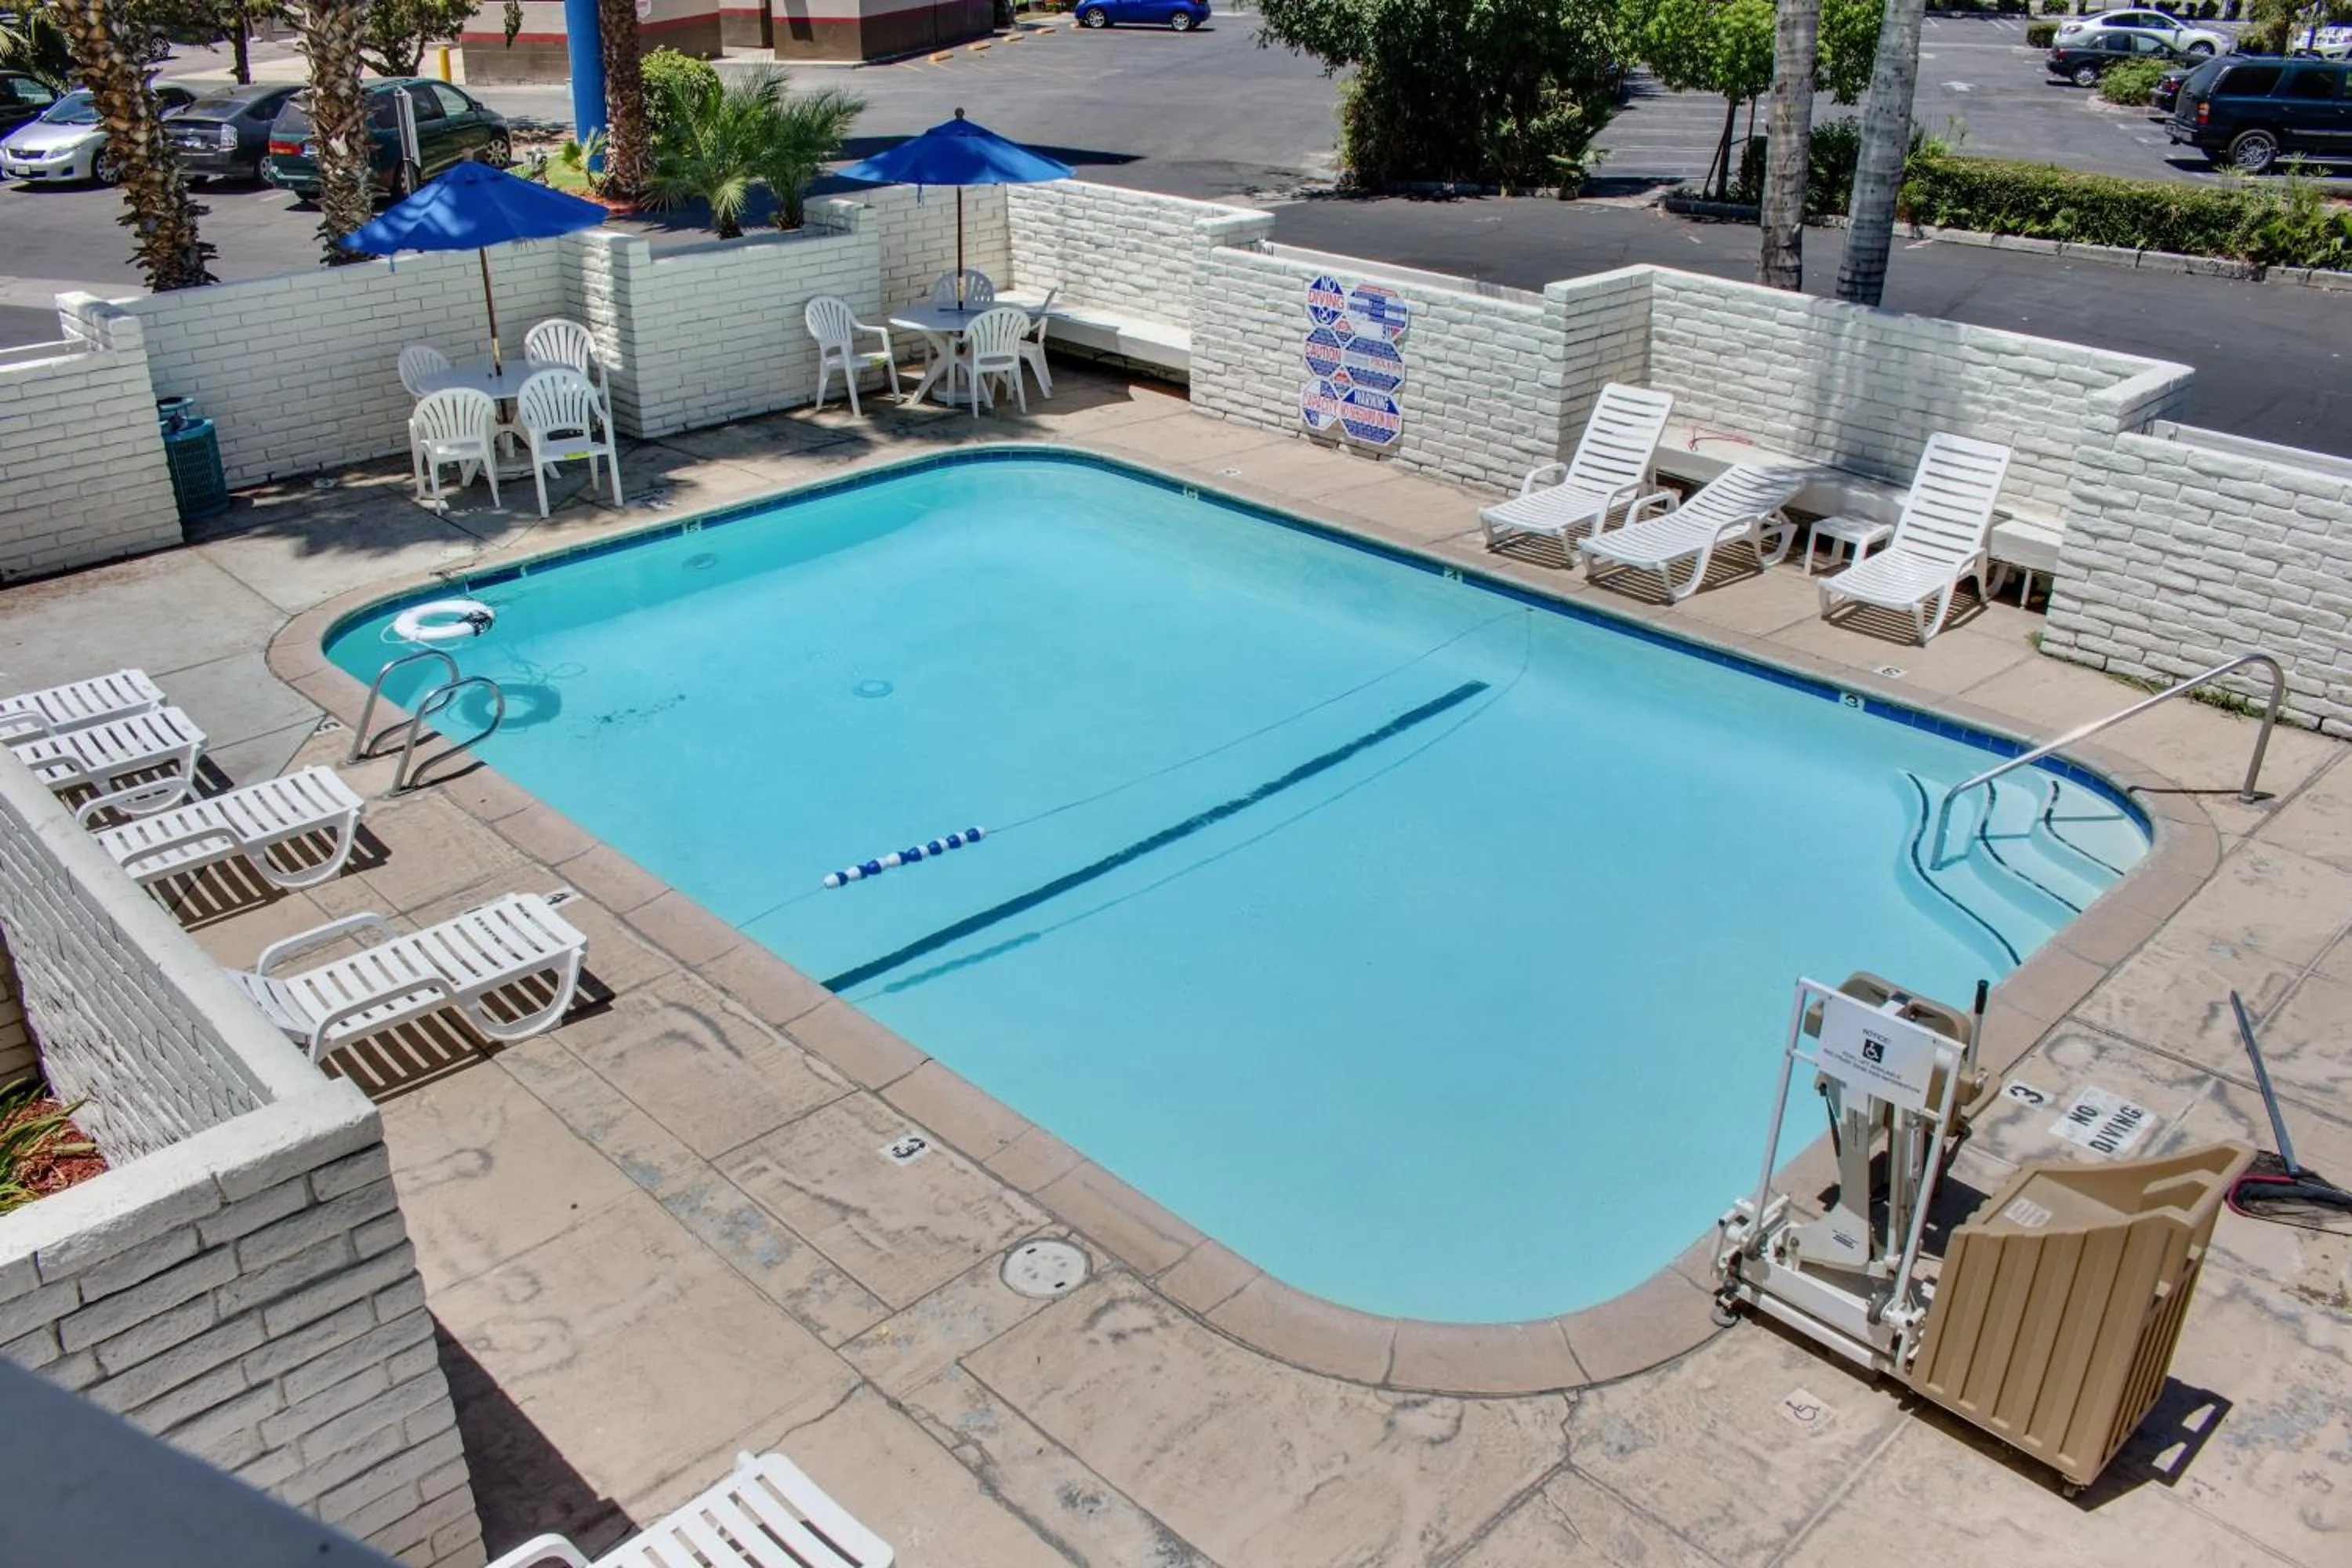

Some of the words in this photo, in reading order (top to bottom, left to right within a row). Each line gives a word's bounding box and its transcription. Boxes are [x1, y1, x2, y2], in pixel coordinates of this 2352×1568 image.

[1320, 275, 1336, 292] NO
[1308, 289, 1344, 310] DIVING
[1305, 342, 1341, 363] CAUTION
[1302, 392, 1338, 416] CAPACITY
[1354, 389, 1389, 412] WARNING
[1844, 694, 1858, 708] 3
[2009, 1085, 2045, 1105] 3
[2068, 1104, 2098, 1127] NO
[2087, 1105, 2144, 1154] DIVING
[891, 1137, 926, 1158] 3
